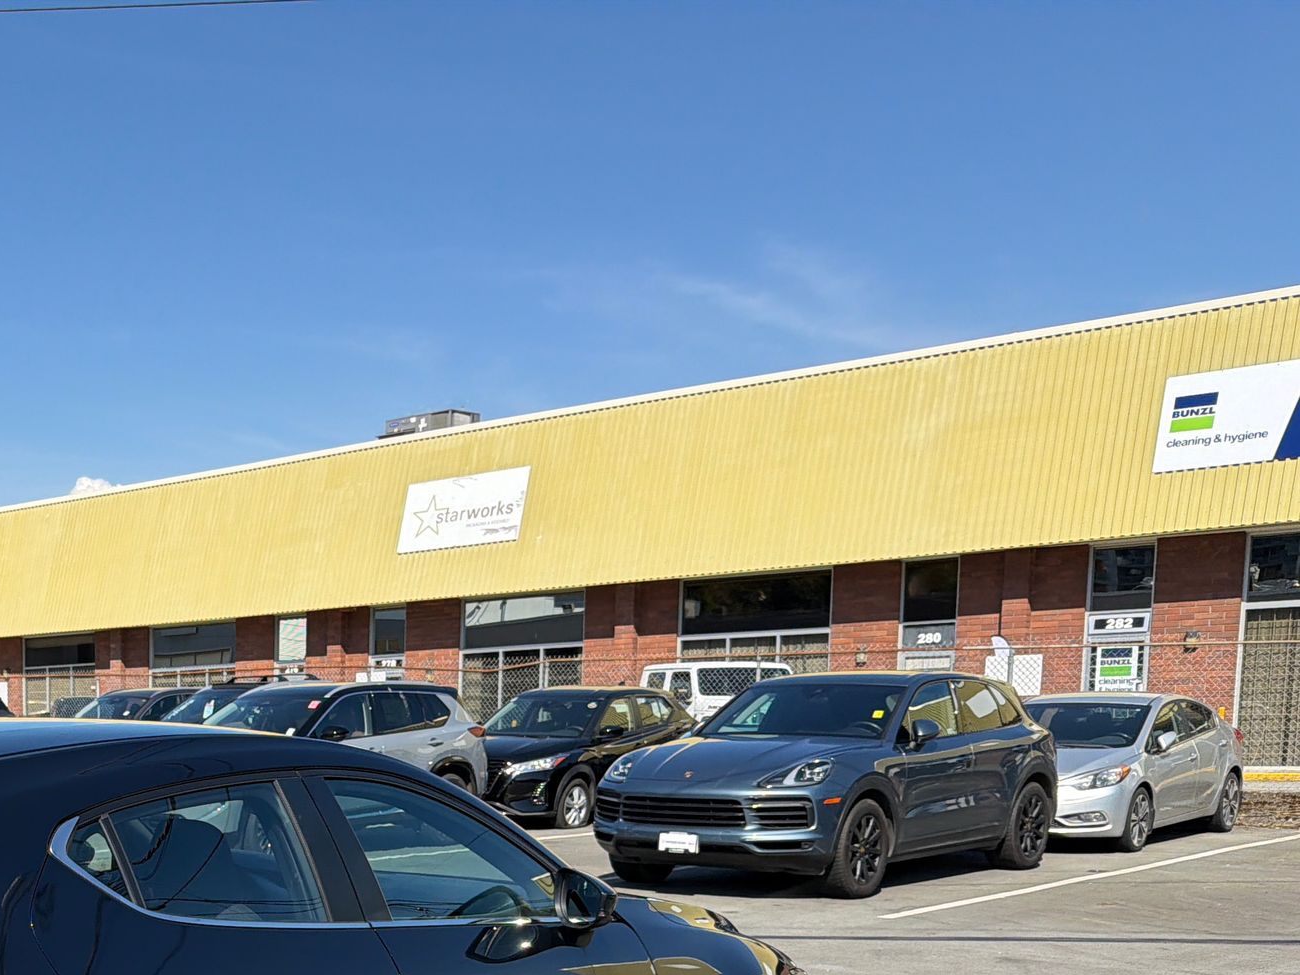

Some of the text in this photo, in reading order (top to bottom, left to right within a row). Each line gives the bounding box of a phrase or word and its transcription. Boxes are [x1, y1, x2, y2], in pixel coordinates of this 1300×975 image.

[1171, 406, 1216, 419] BUNZL
[1166, 430, 1269, 449] cleaning & hygiene
[436, 500, 515, 525] starworks
[1105, 617, 1134, 630] 282
[916, 632, 942, 644] 280
